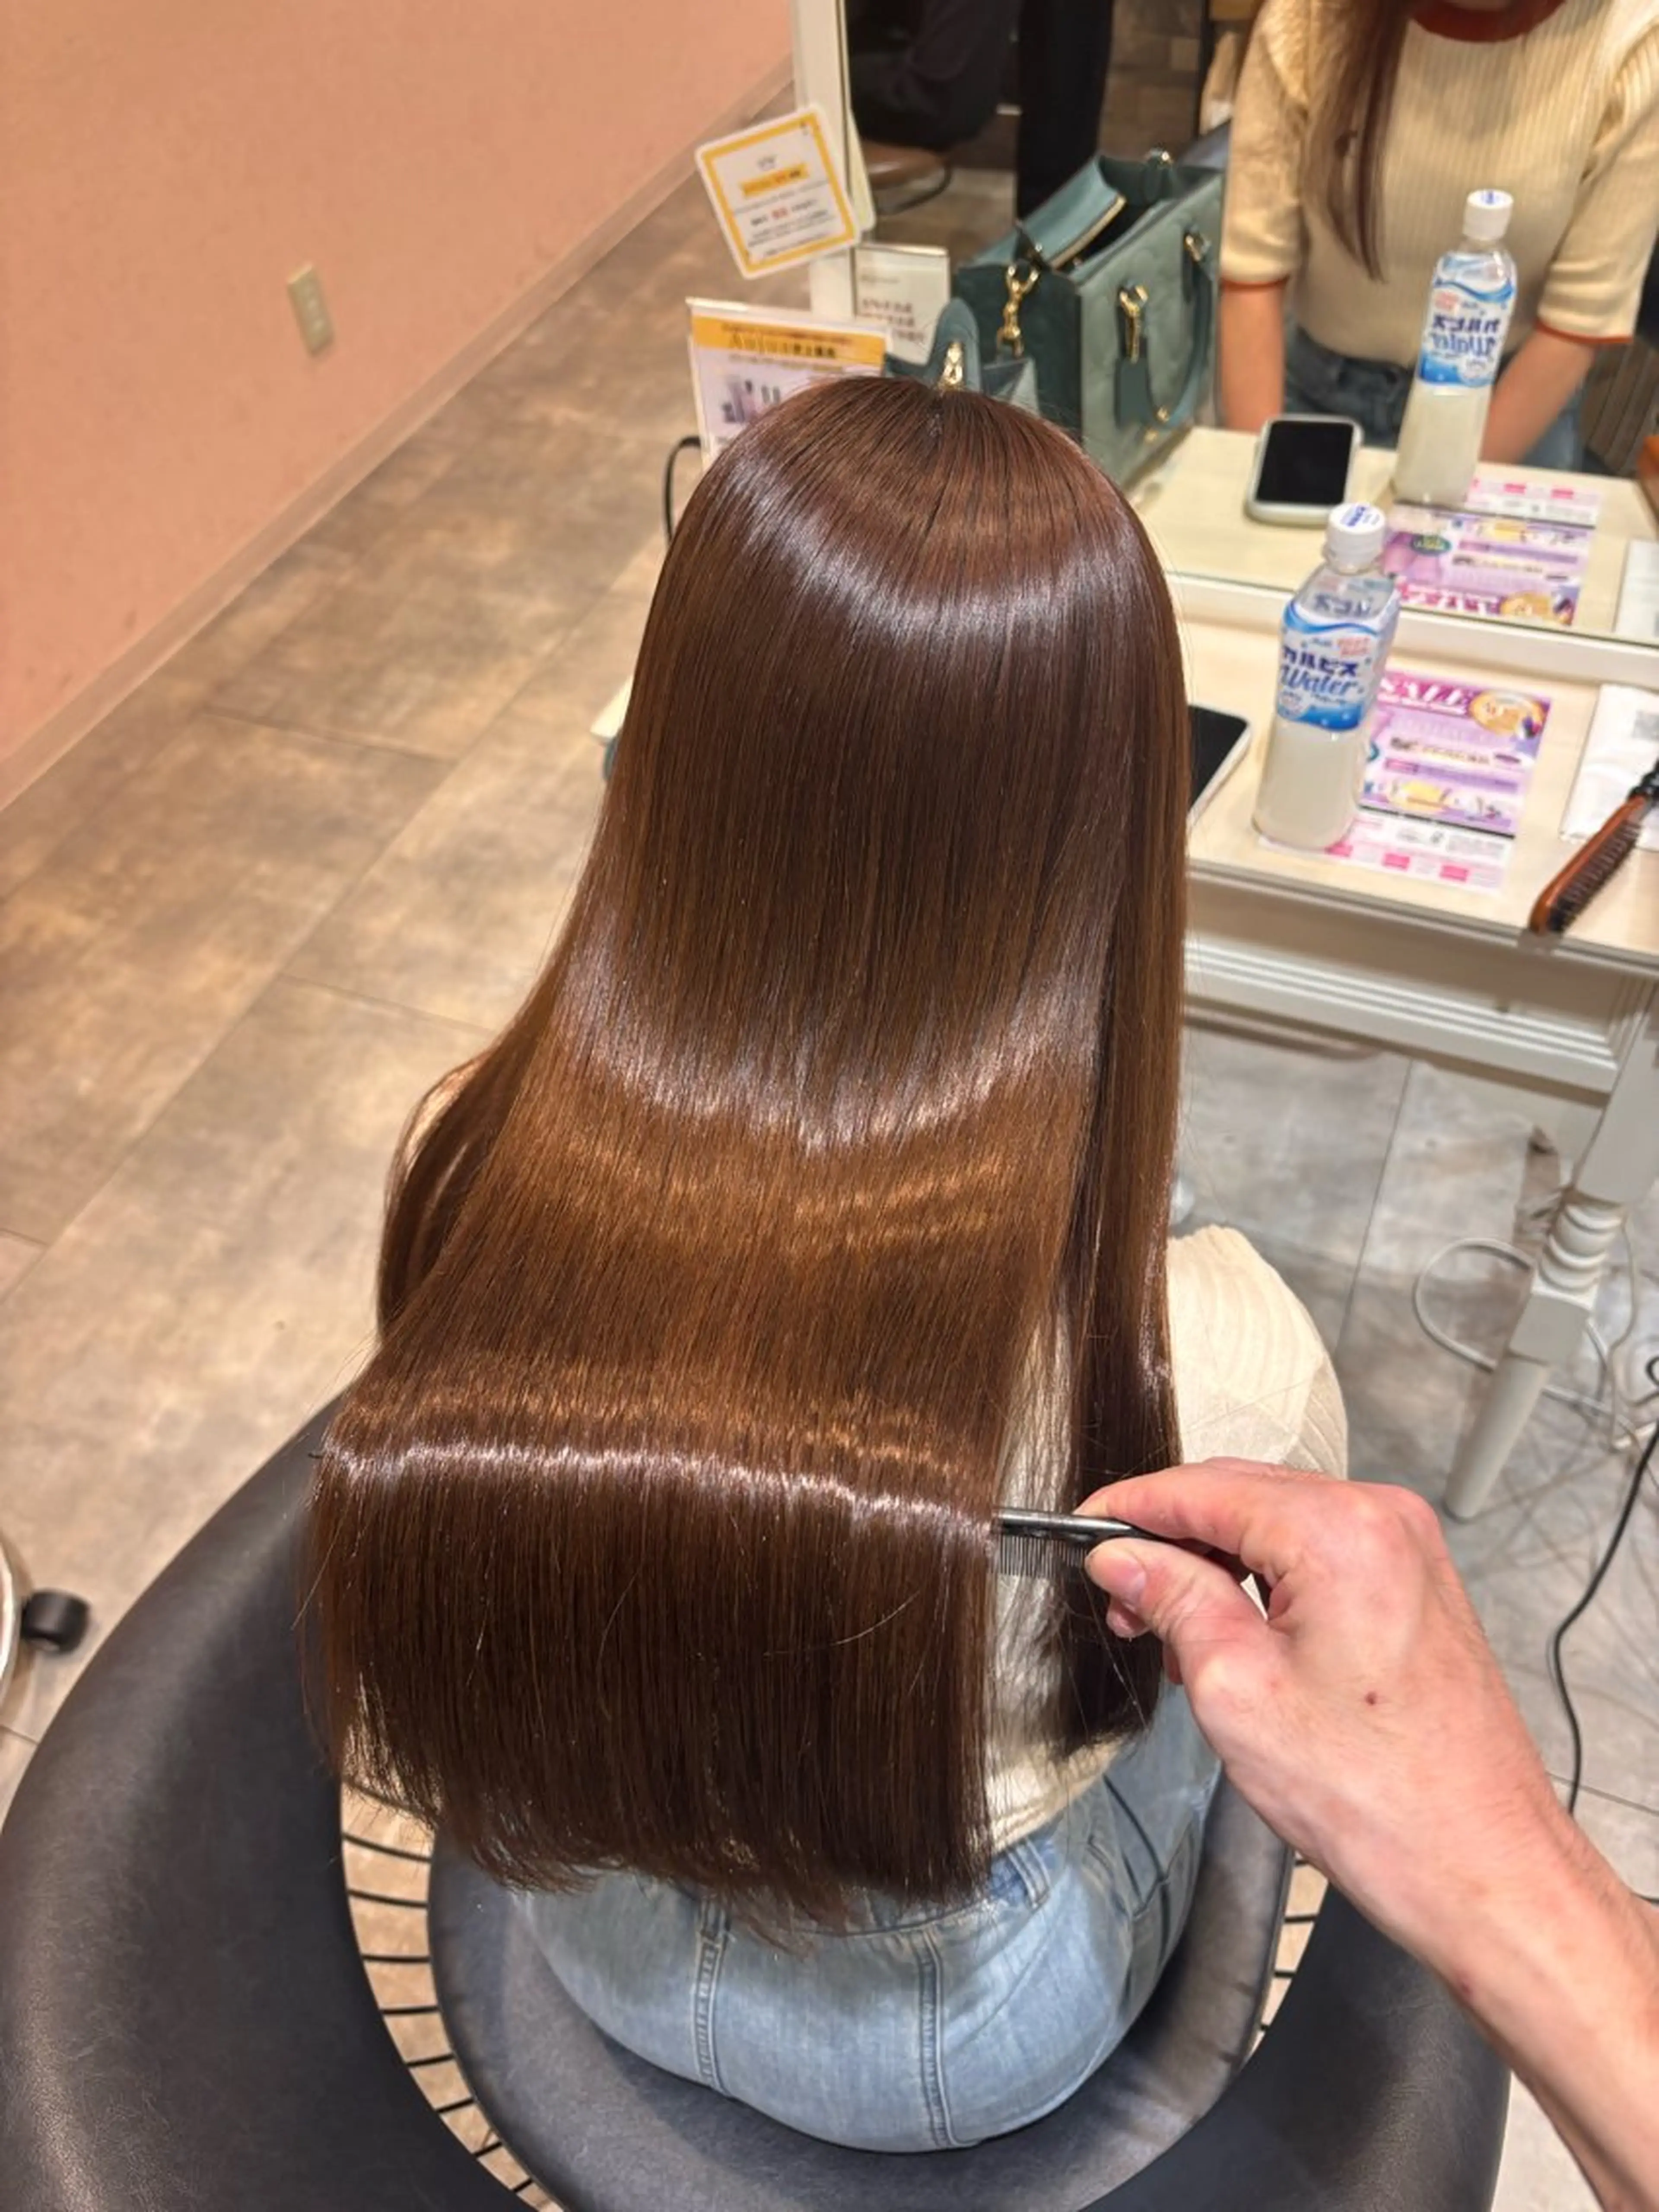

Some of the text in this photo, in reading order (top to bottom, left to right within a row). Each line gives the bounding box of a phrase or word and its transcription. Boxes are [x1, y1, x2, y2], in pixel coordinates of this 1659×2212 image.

[1282, 644, 1359, 677] カルピス
[1280, 664, 1359, 695] Water
